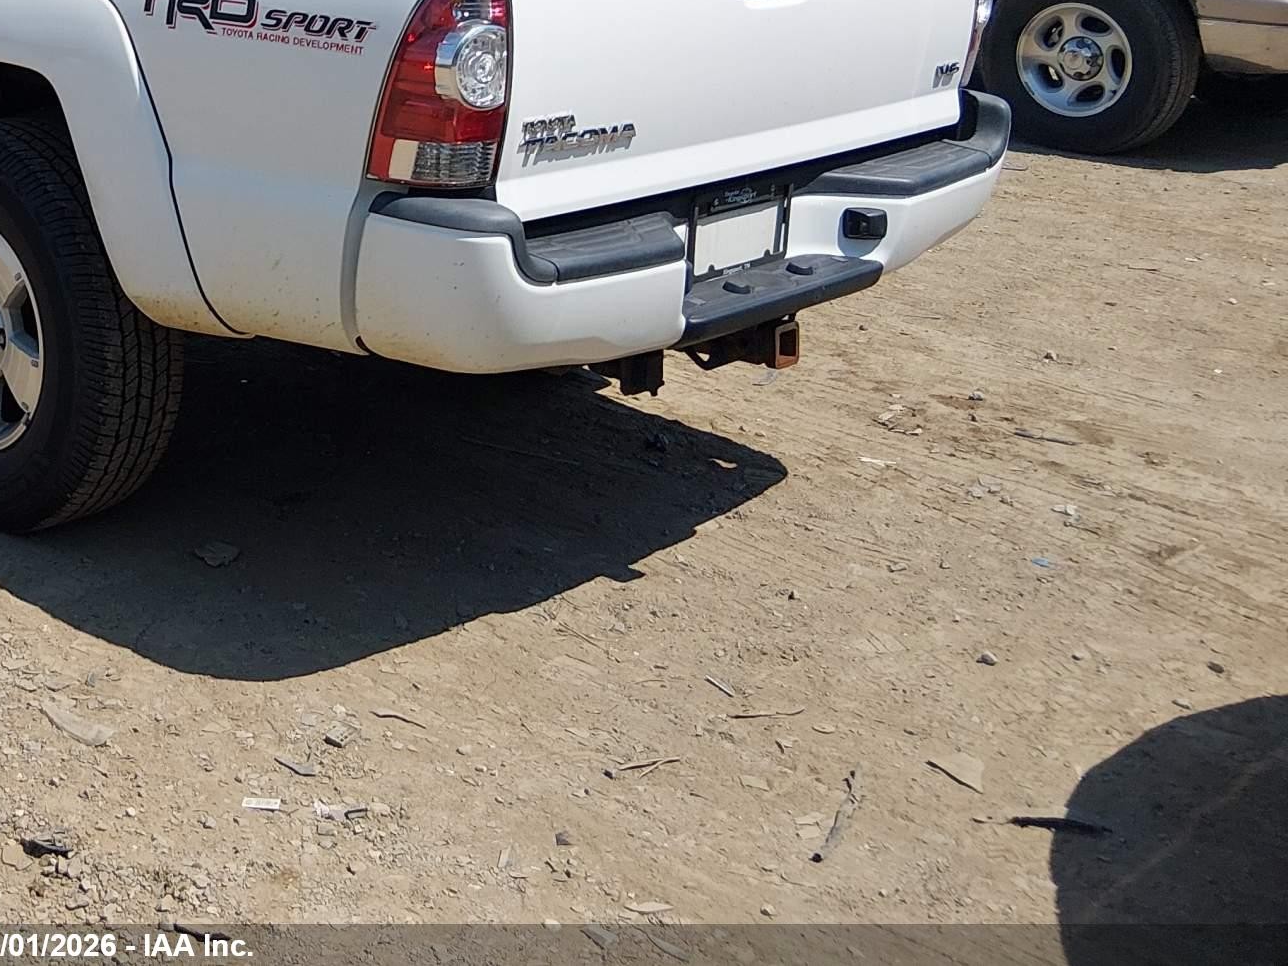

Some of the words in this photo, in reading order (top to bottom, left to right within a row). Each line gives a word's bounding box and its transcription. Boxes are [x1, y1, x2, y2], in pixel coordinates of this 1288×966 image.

[221, 27, 254, 40] TOYOTA
[256, 32, 290, 45] RACING
[292, 37, 365, 55] DEVELOPMENT
[260, 9, 376, 42] SPORT
[517, 123, 637, 156] TACOMA
